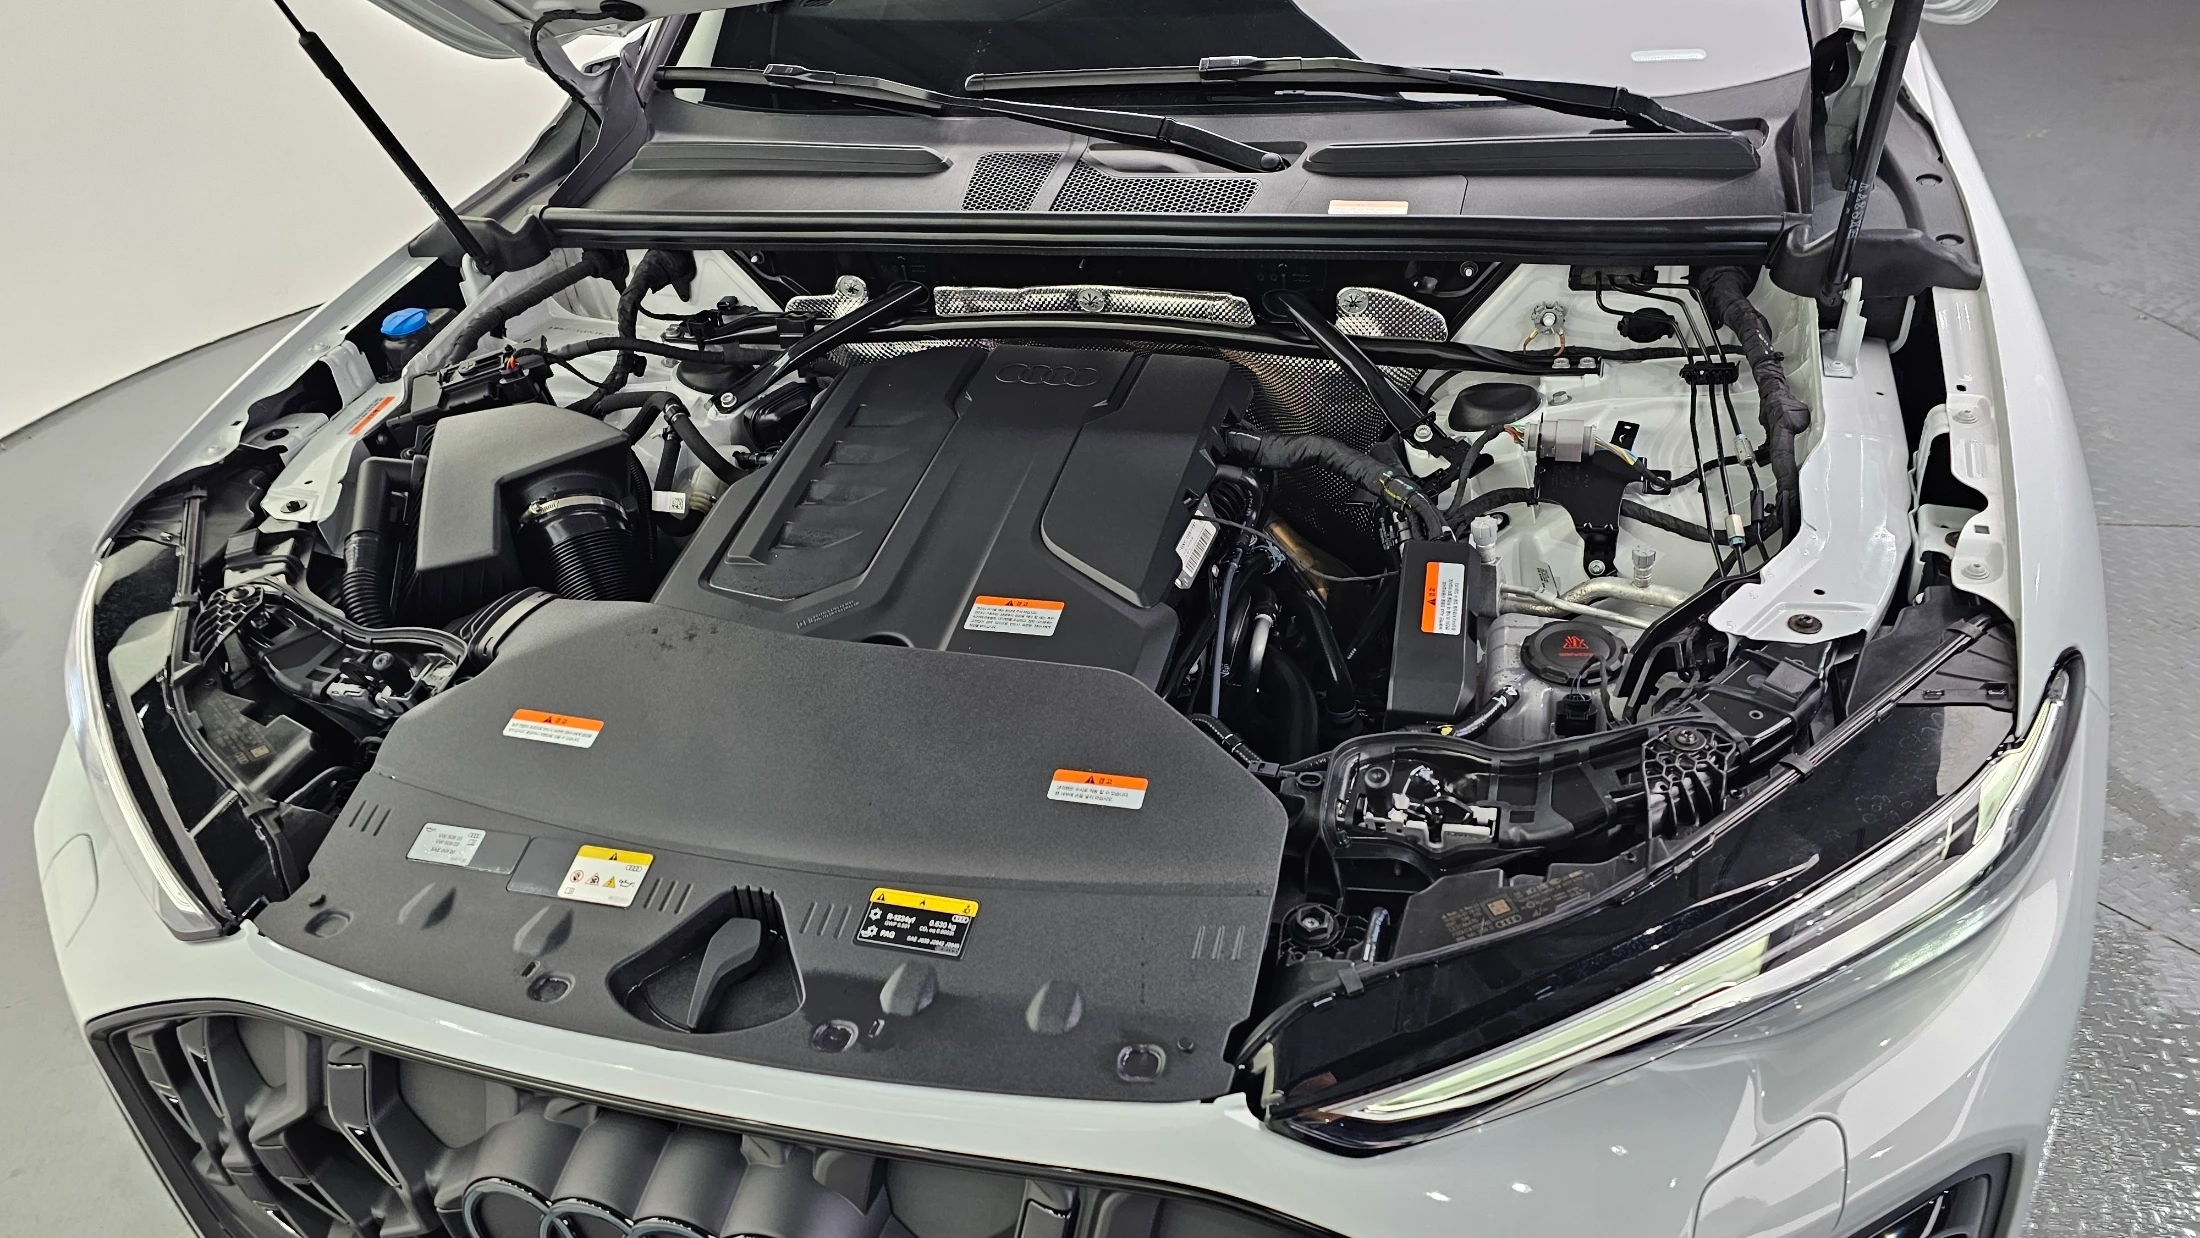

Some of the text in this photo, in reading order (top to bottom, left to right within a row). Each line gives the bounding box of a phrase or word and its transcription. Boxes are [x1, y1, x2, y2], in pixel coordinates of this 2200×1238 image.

[886, 912, 916, 924] R-1234yf
[948, 922, 956, 931] kg
[880, 929, 896, 938] PAG
